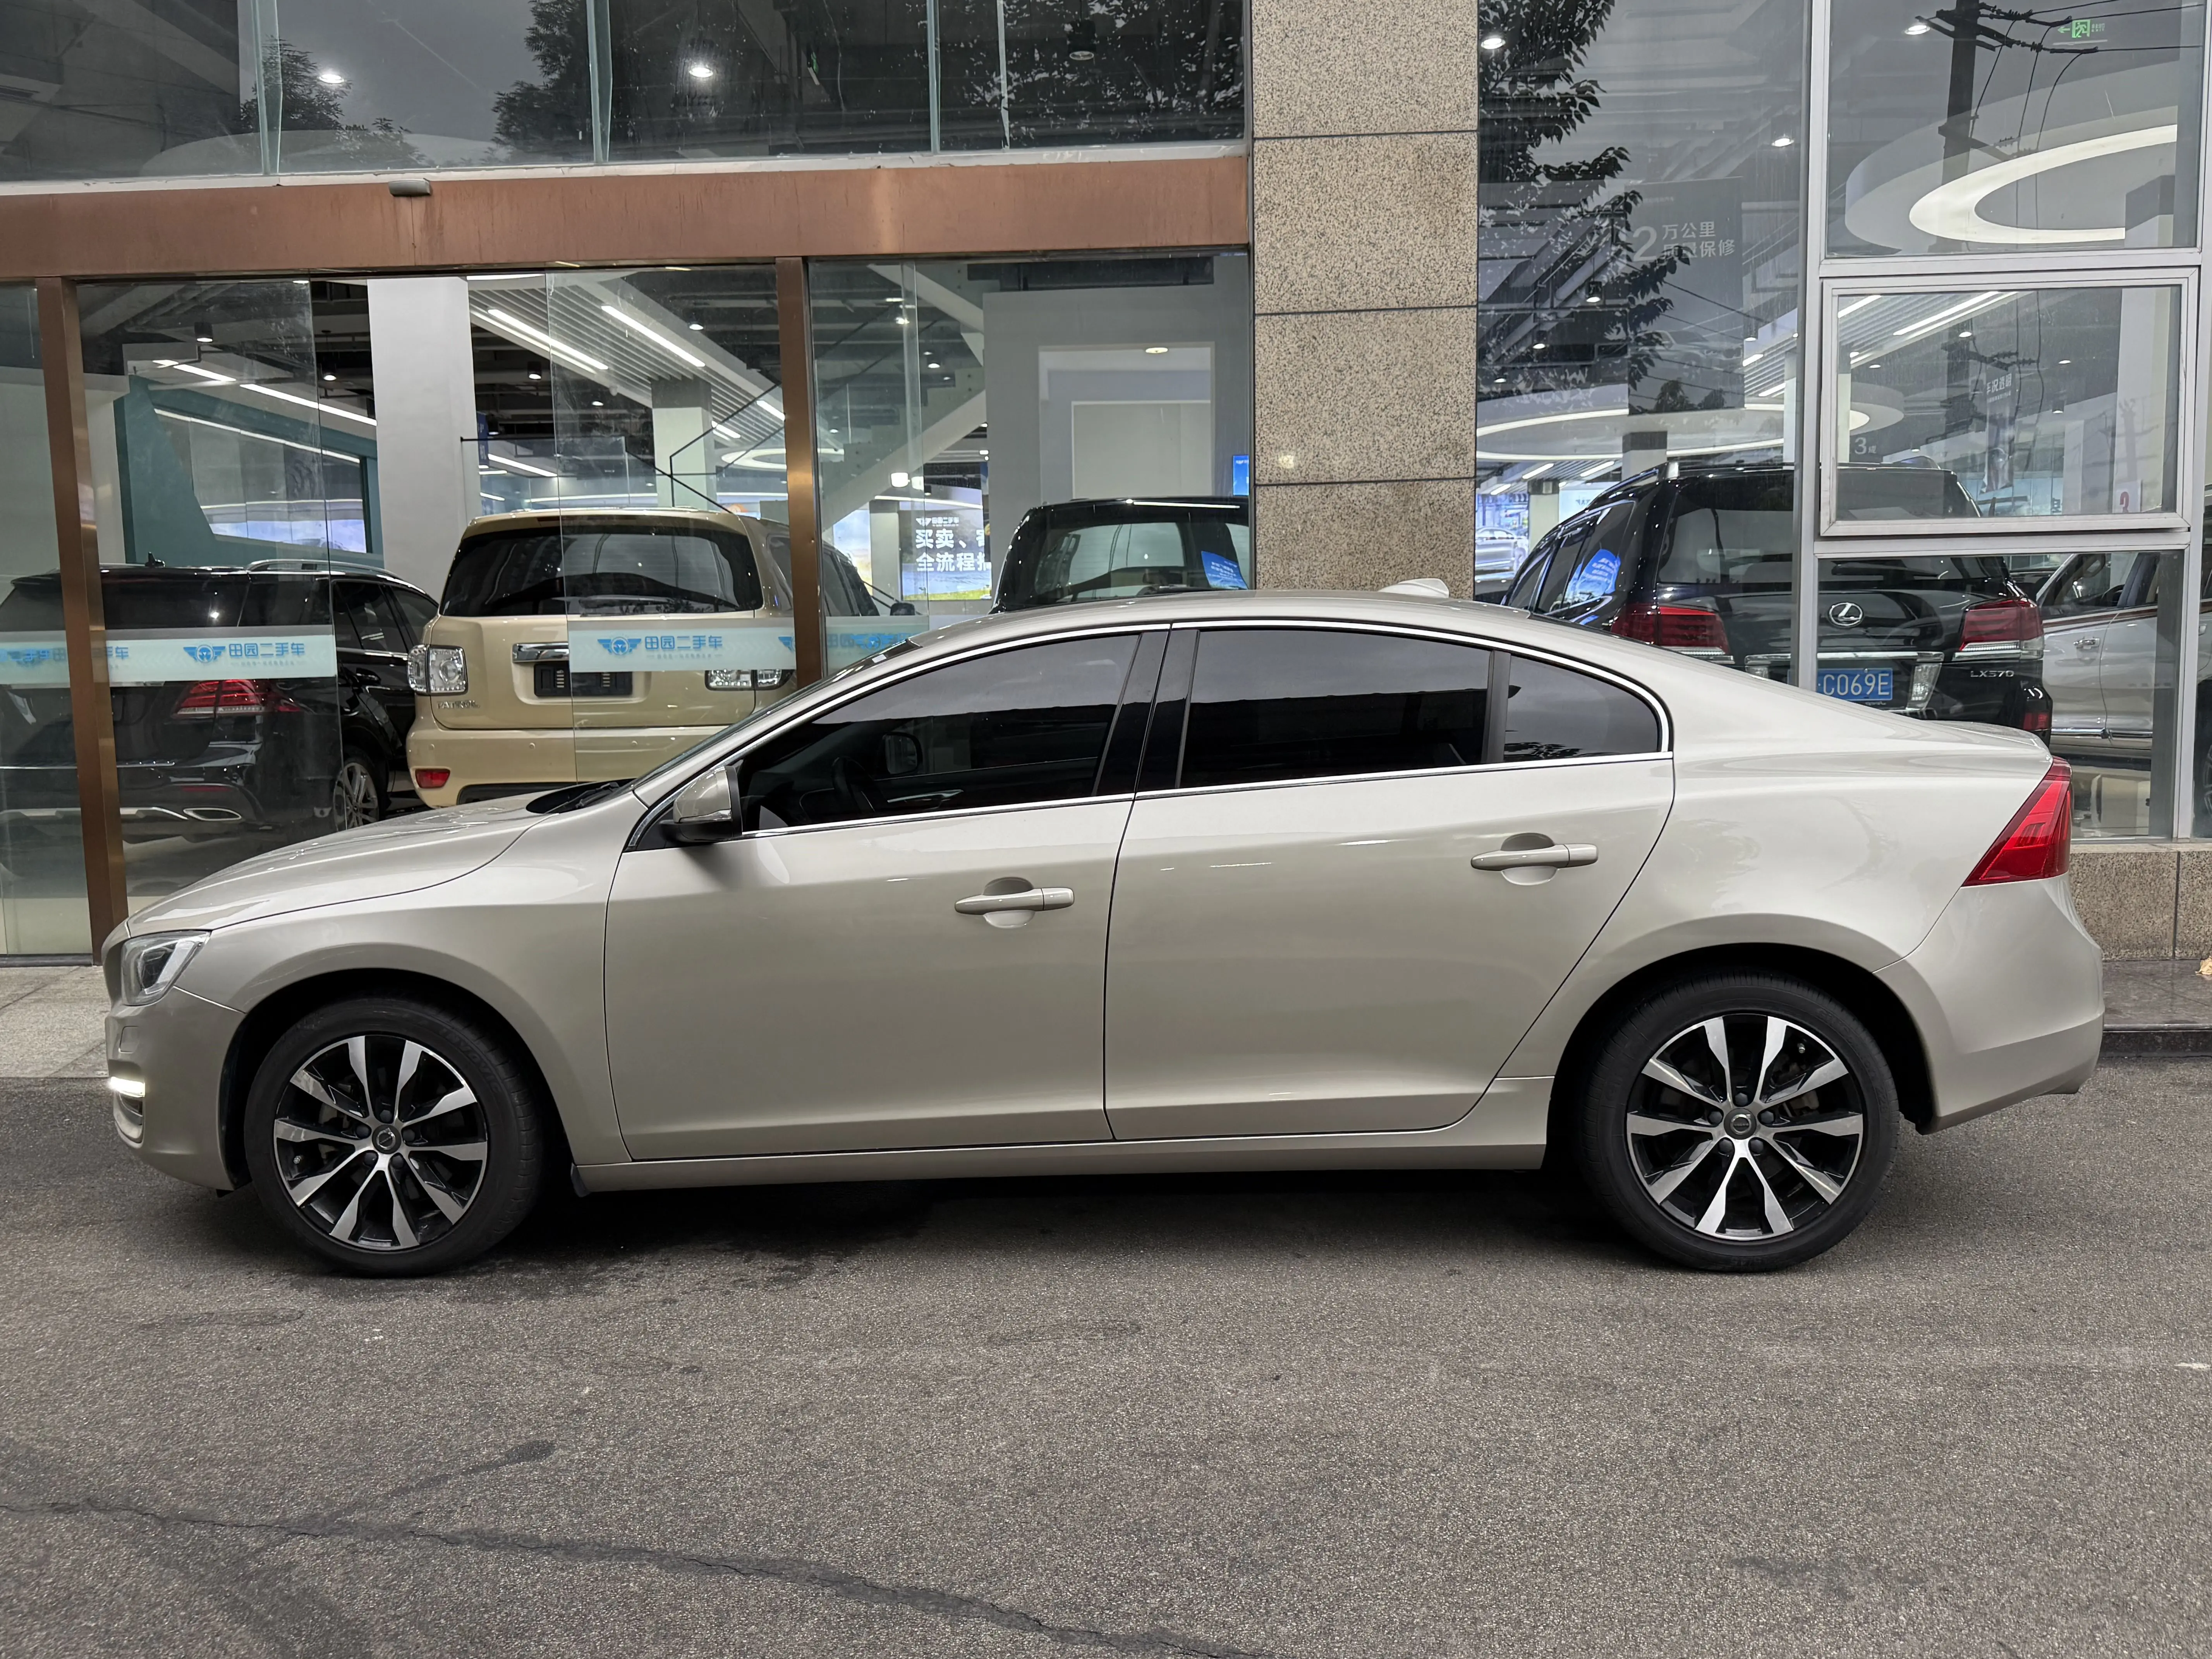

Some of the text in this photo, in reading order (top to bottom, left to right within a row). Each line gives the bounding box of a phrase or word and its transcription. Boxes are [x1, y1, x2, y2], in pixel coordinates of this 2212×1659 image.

[1633, 222, 1716, 261] 2 万公里
[229, 642, 305, 657] 田园二手车
[645, 635, 723, 649] 田园二手车
[1823, 673, 1890, 696] C069E
[437, 700, 480, 709] PATROL
